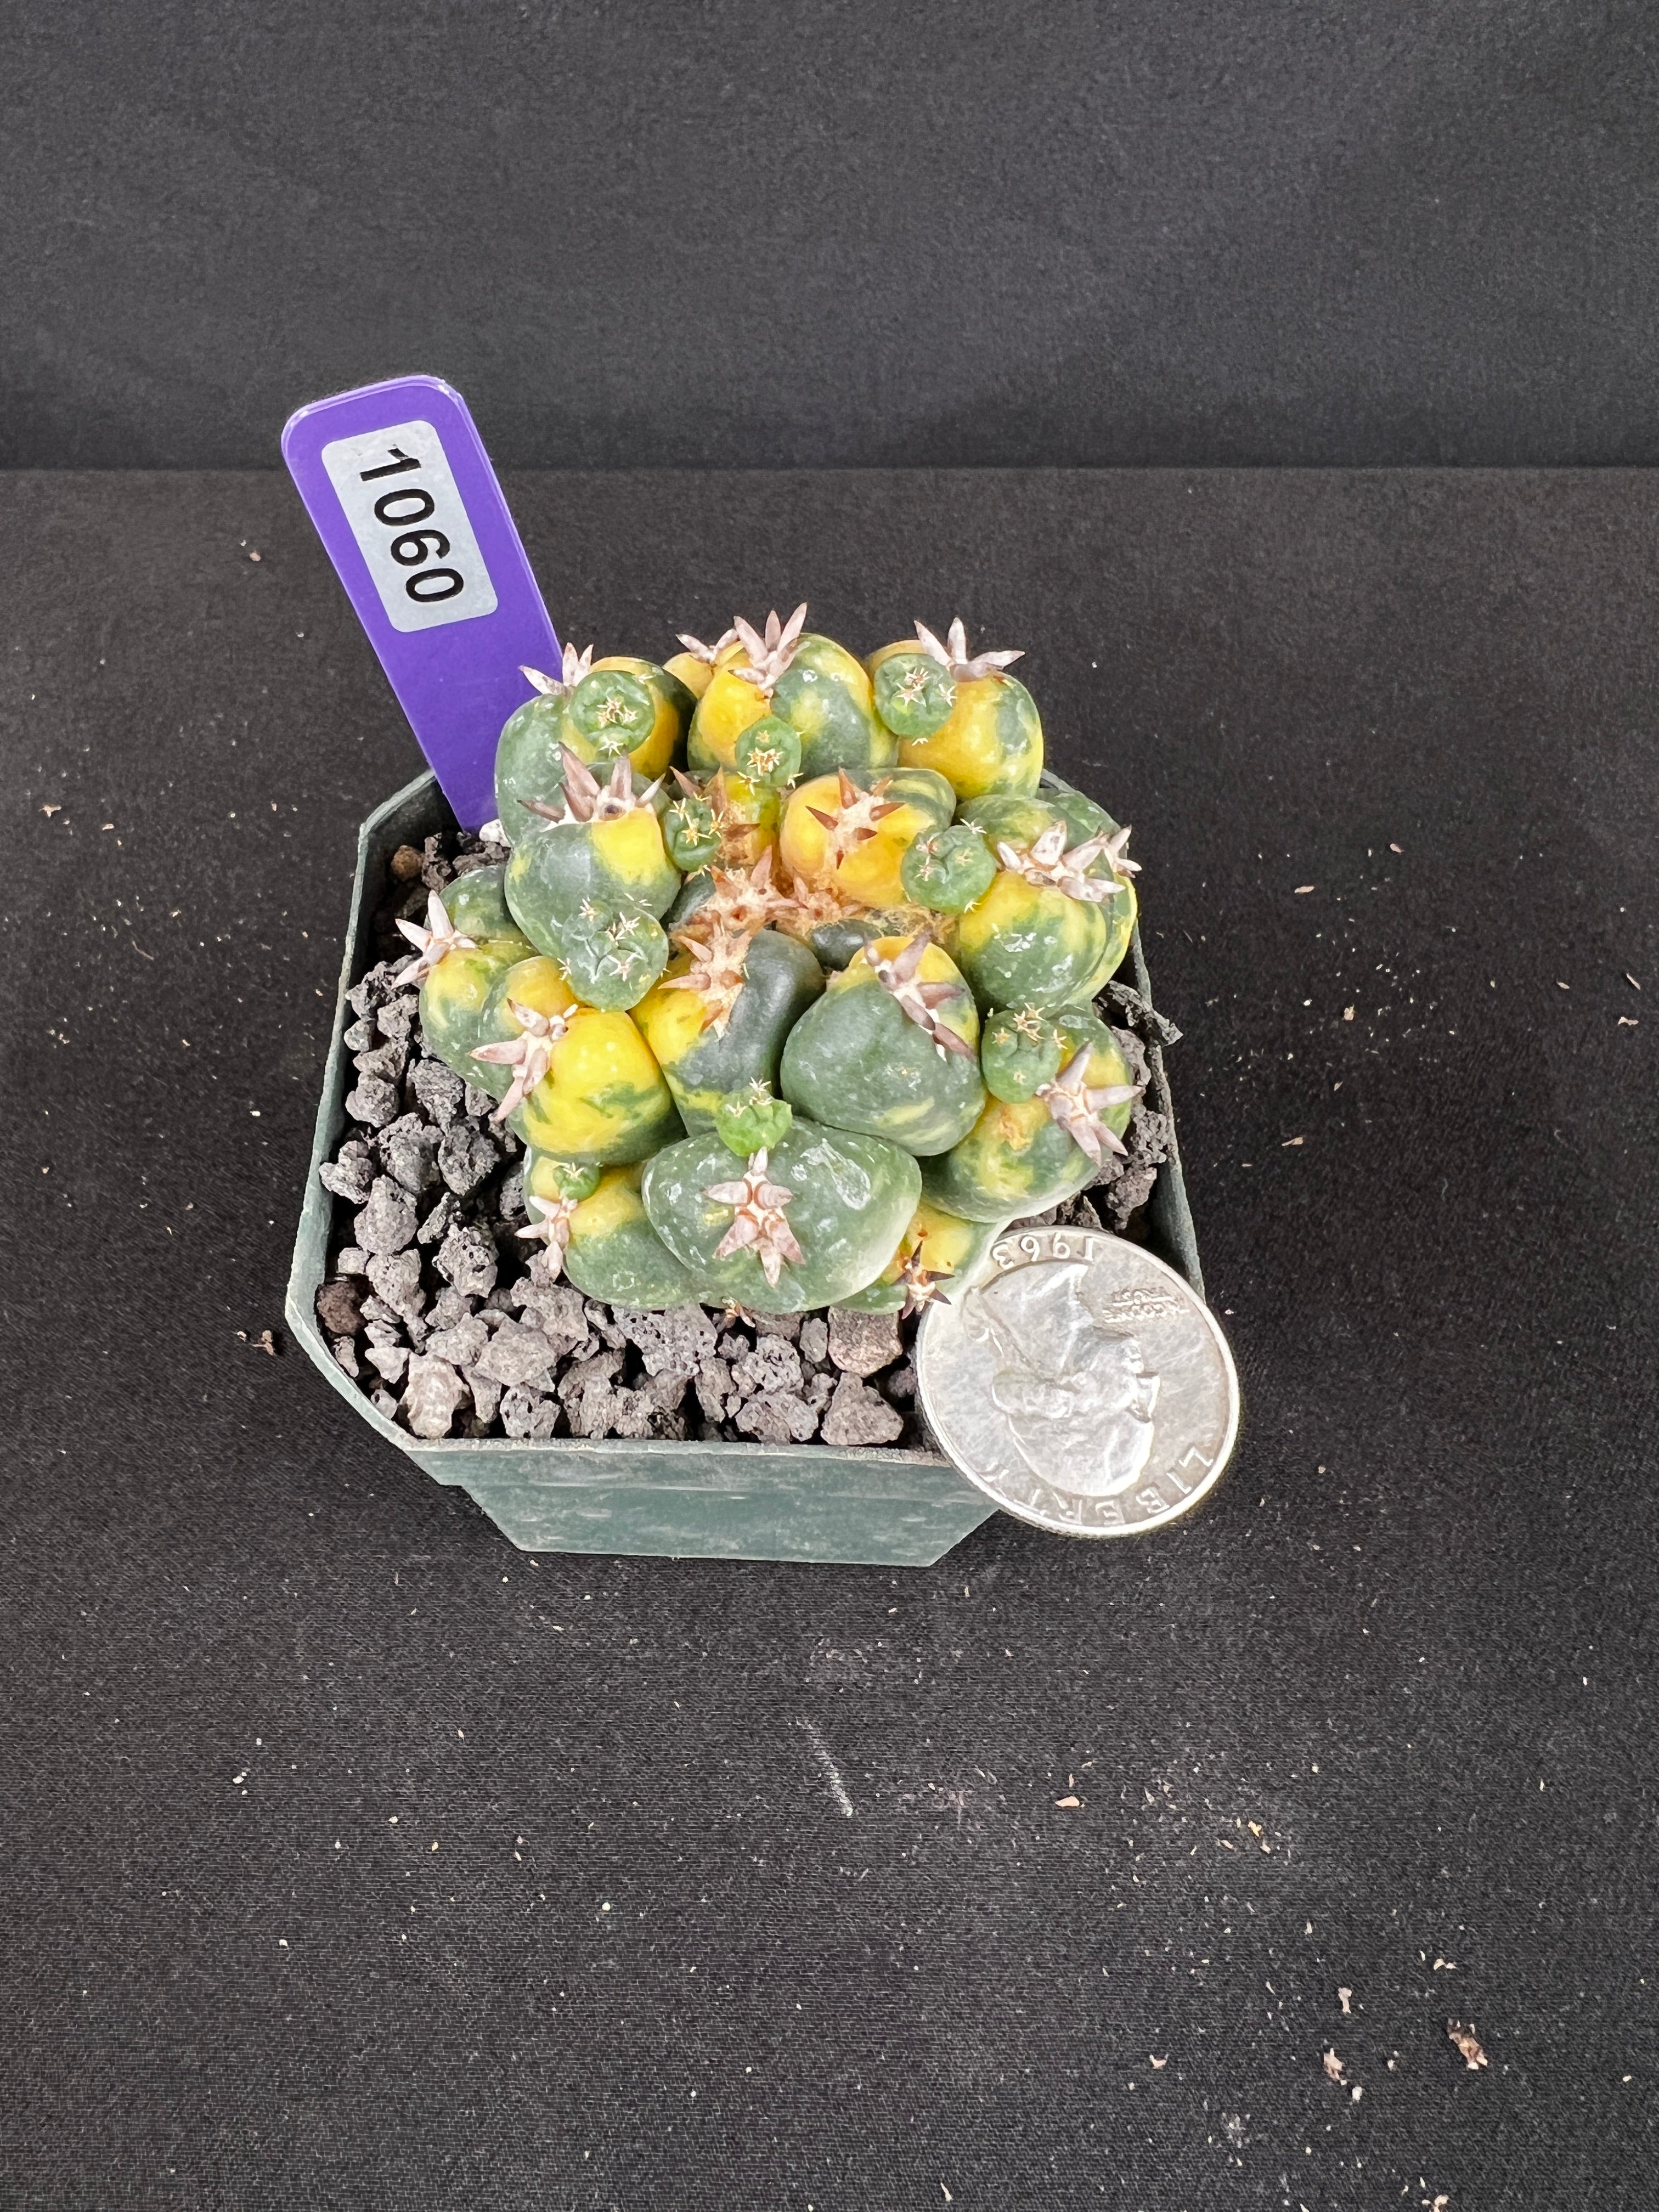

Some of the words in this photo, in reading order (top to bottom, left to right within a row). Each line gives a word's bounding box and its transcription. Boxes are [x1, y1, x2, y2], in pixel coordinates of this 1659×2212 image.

[359, 445, 464, 603] 1060
[992, 1233, 1096, 1269] 1963
[978, 1446, 1214, 1525] LIBERTY
